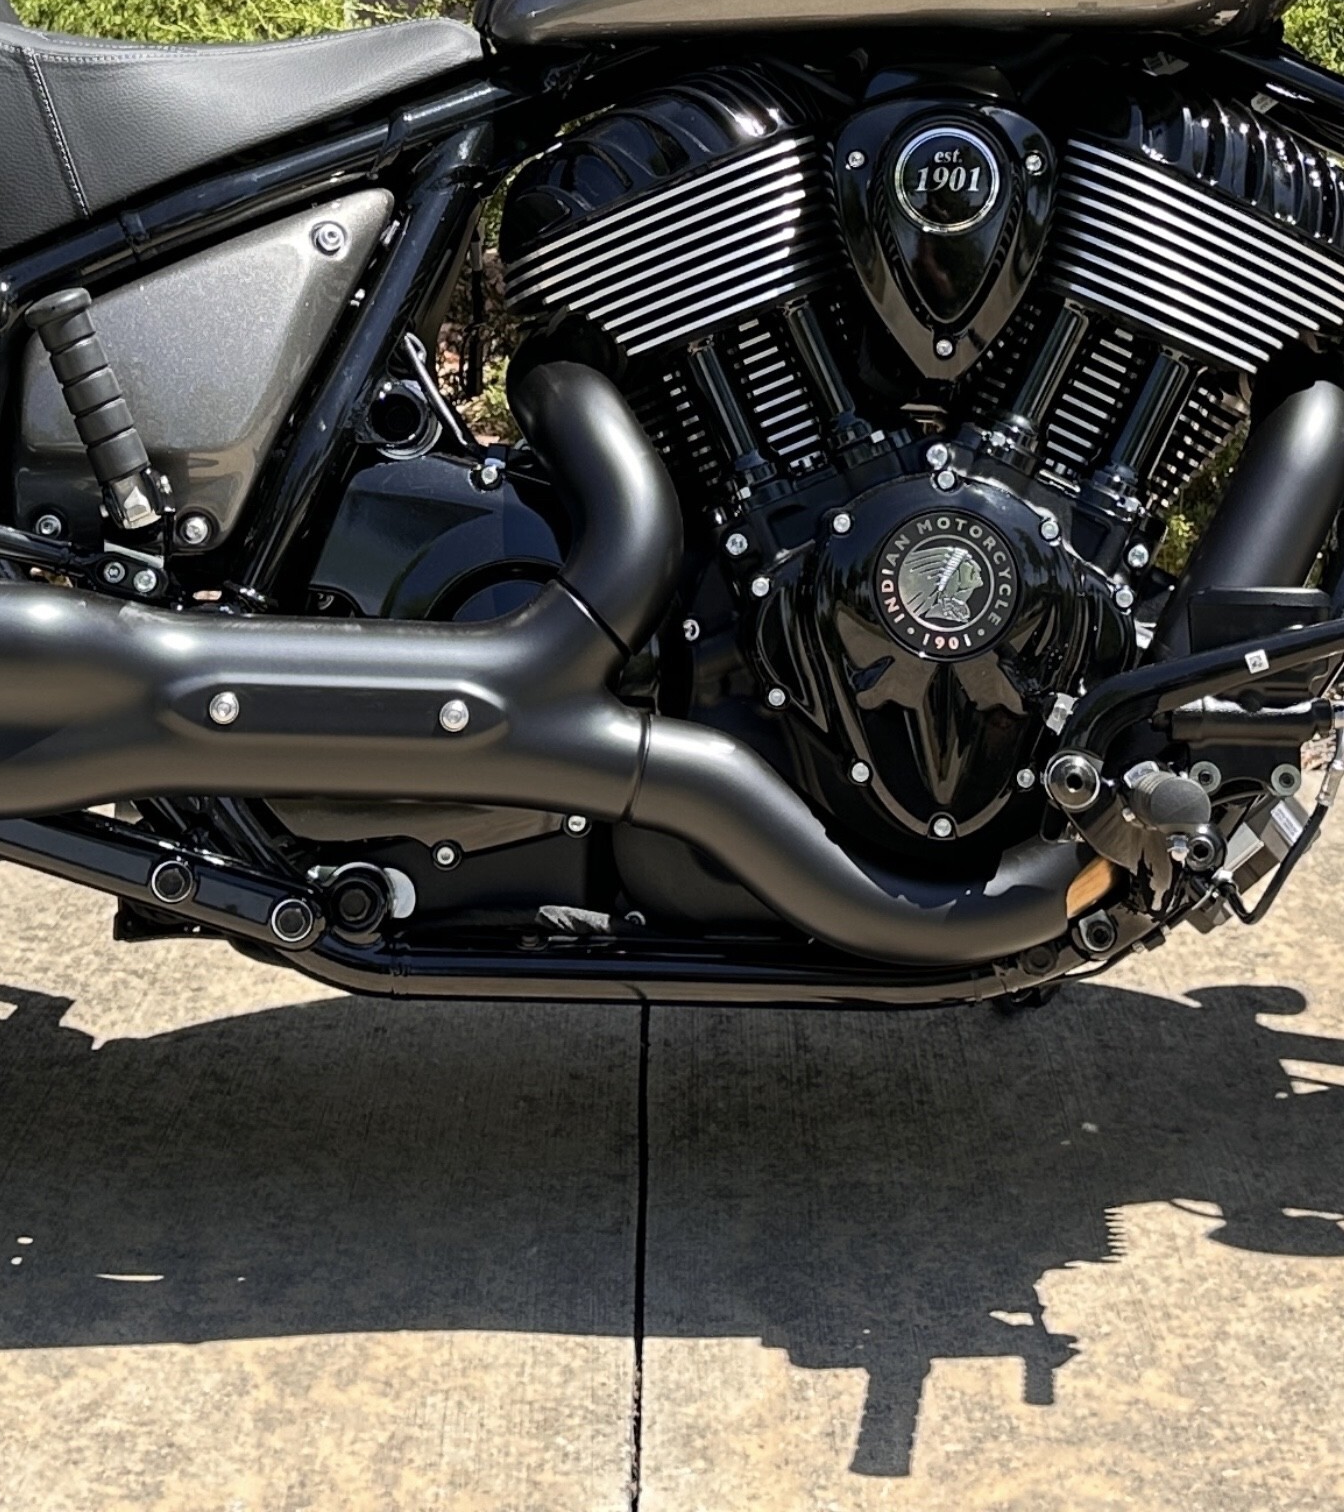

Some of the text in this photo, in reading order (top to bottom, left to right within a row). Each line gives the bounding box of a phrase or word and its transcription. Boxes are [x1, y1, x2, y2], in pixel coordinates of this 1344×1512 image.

[934, 148, 962, 163] est.
[915, 166, 981, 192] 1901
[881, 517, 1012, 626] INDIAN MOTORCYCLE
[922, 633, 972, 650] 1901
